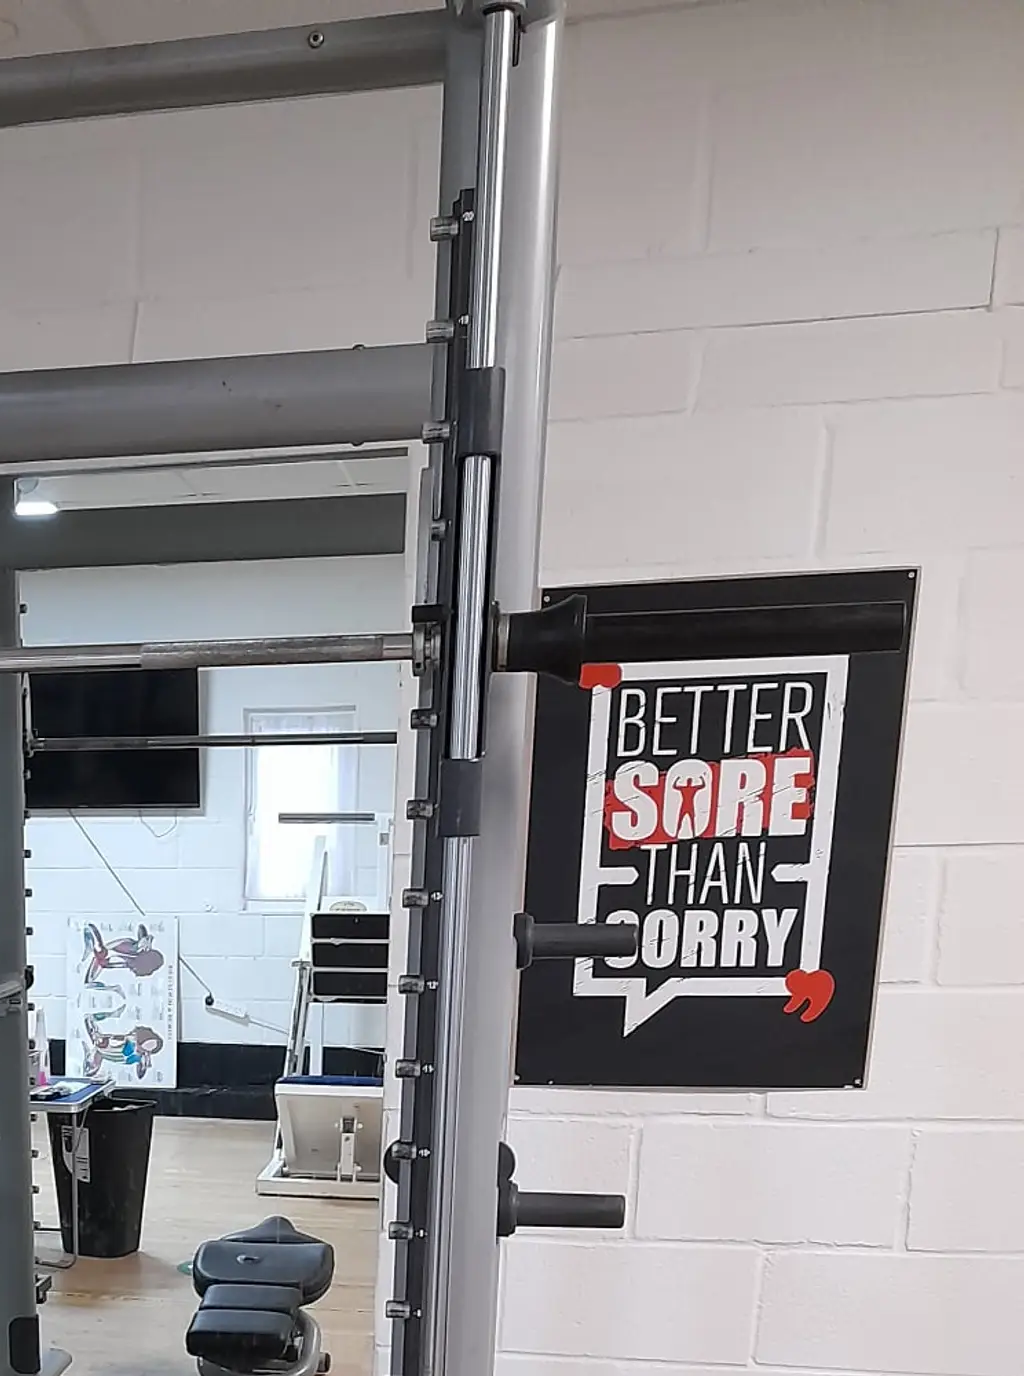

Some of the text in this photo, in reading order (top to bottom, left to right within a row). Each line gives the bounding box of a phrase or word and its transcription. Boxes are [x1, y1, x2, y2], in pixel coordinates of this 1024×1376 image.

[616, 681, 814, 758] BETTER
[611, 758, 812, 840] SORE
[640, 842, 765, 905] THAN
